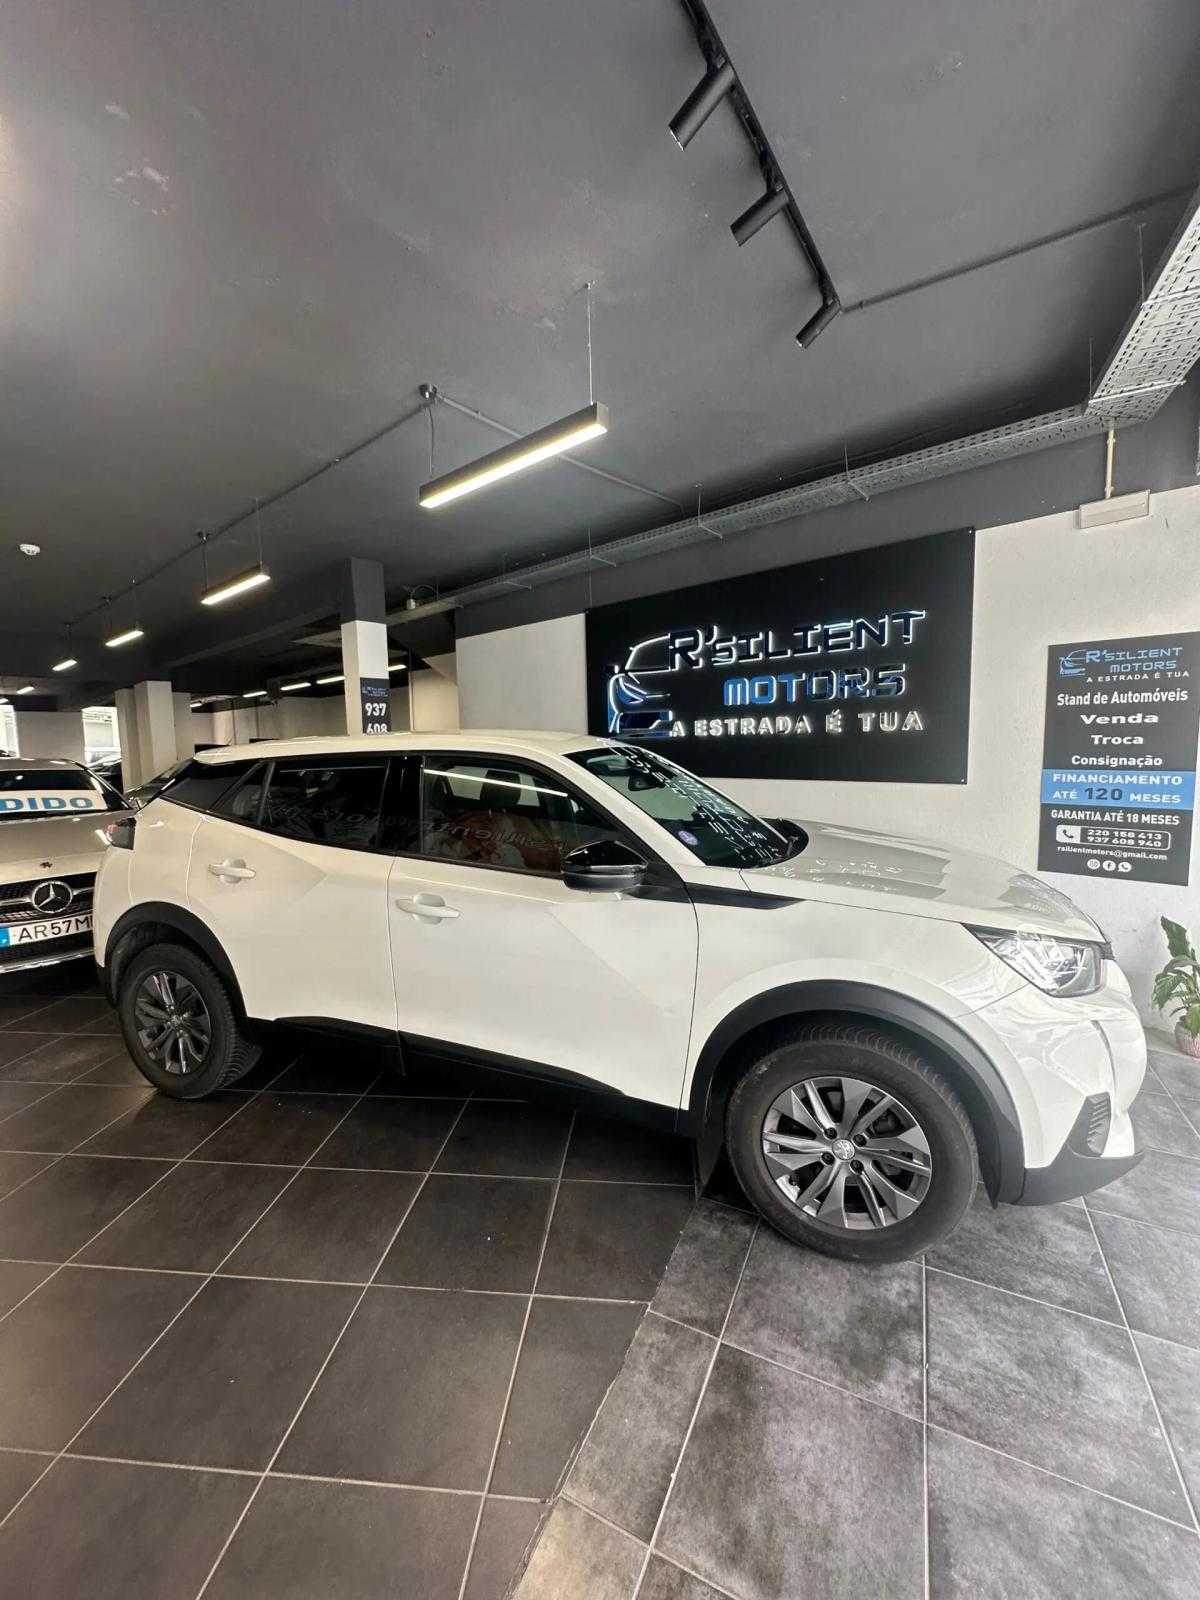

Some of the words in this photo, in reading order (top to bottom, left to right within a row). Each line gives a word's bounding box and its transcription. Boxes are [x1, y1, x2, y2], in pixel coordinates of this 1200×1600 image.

[1110, 660, 1177, 673] MOTORS
[1098, 673, 1149, 682] ESTRADA
[724, 663, 906, 706] MOTORS
[1057, 692, 1091, 706] Stand
[1093, 692, 1108, 704] de
[1111, 688, 1188, 703] Automóveis
[365, 702, 387, 716] 937
[669, 720, 686, 737] A
[694, 715, 812, 737] ESTRADA
[825, 709, 842, 733] É
[858, 711, 924, 733] TUA
[1080, 713, 1159, 724] Venda
[1091, 735, 1144, 745] Troca
[1071, 755, 1163, 768] Consignação
[1052, 773, 1183, 785] FINANCIAMENTO
[1052, 789, 1078, 800] ATÉ
[1084, 787, 1123, 800] 120
[1129, 793, 1181, 803] MESES
[1051, 810, 1101, 821] GARANTIA
[1103, 810, 1123, 822] ATÉ
[1126, 812, 1139, 823] 18
[1141, 814, 1180, 825] MESES
